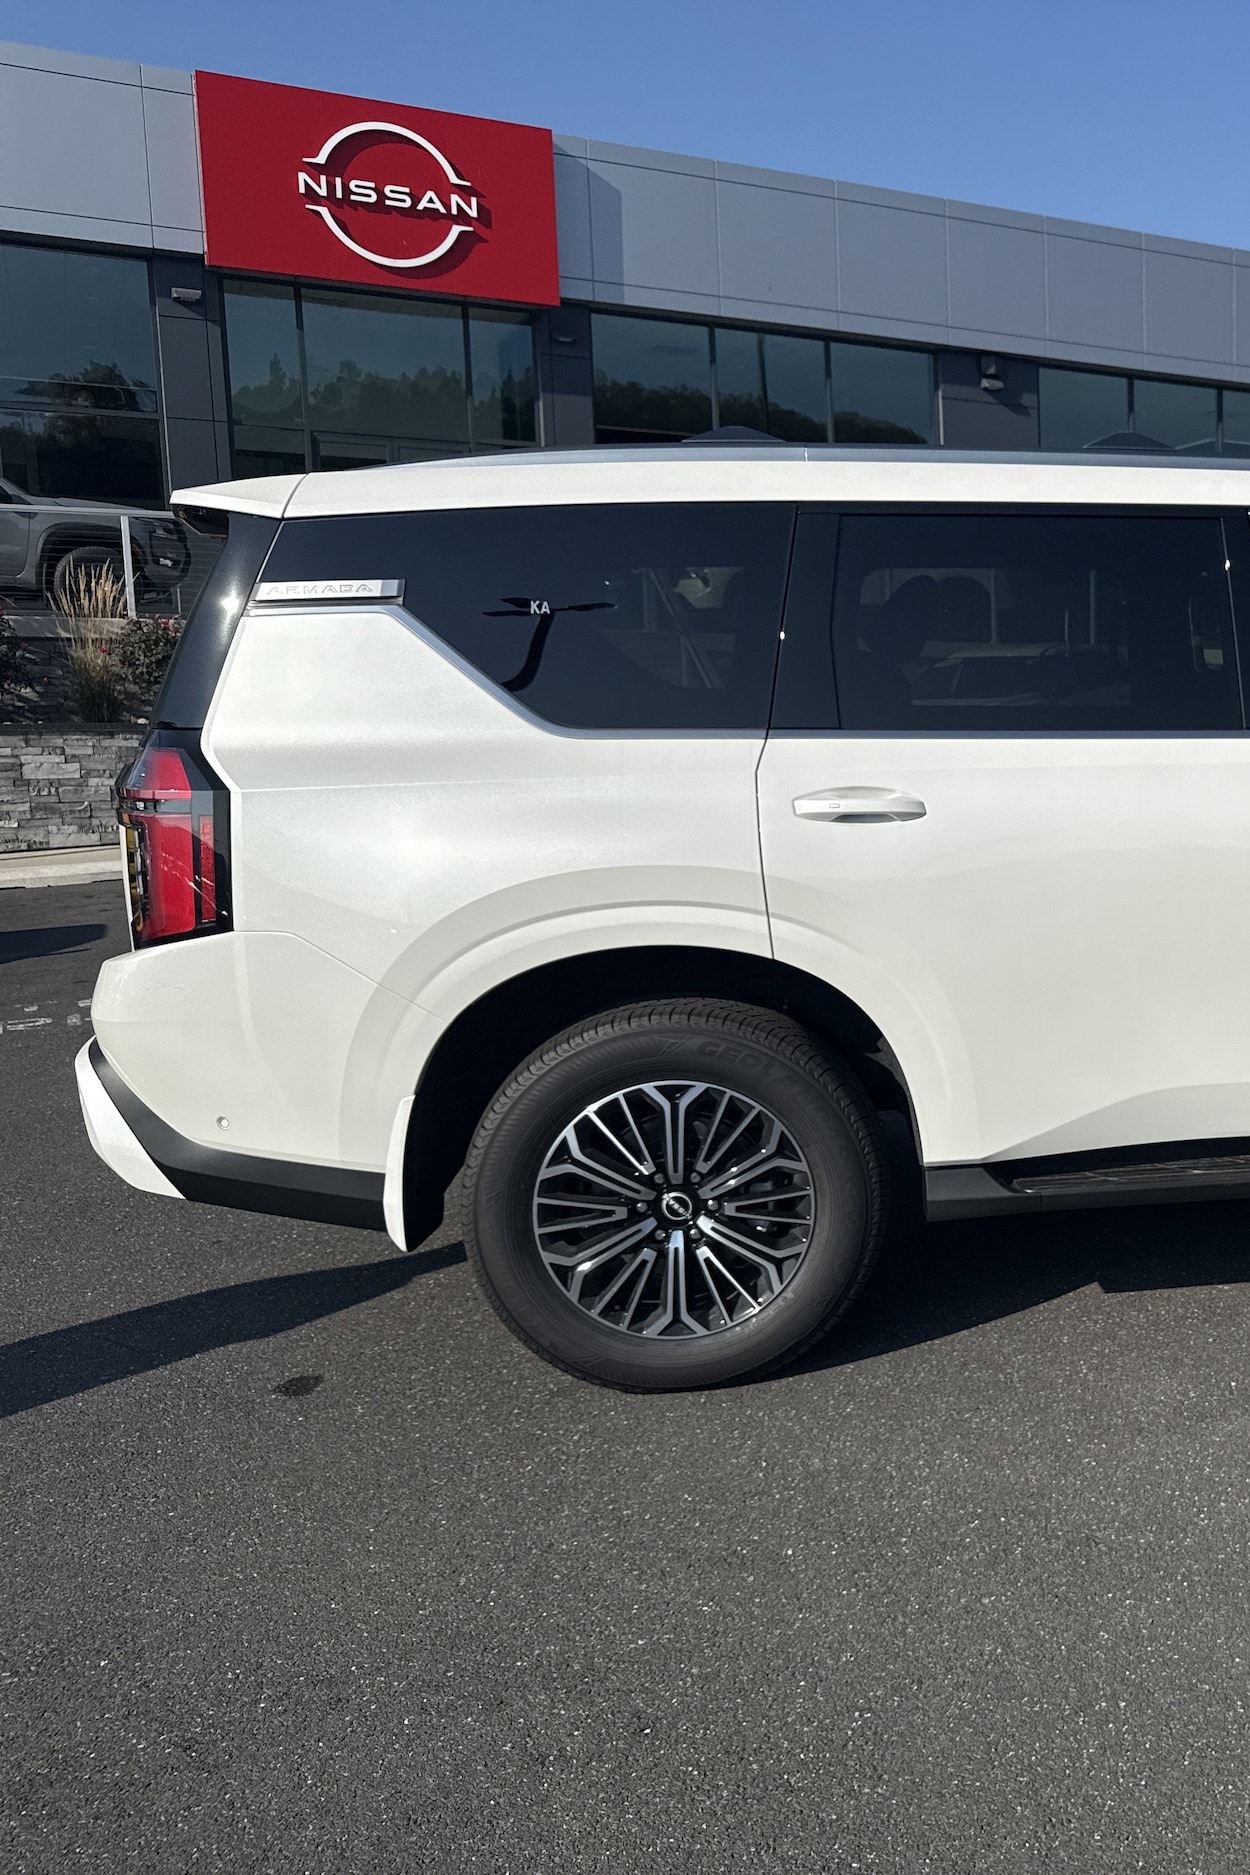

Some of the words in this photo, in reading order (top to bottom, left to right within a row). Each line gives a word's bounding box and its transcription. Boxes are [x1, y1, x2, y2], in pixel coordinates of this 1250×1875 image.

[298, 171, 478, 218] NISSAN
[266, 584, 373, 596] ARMADA
[530, 600, 550, 614] KA
